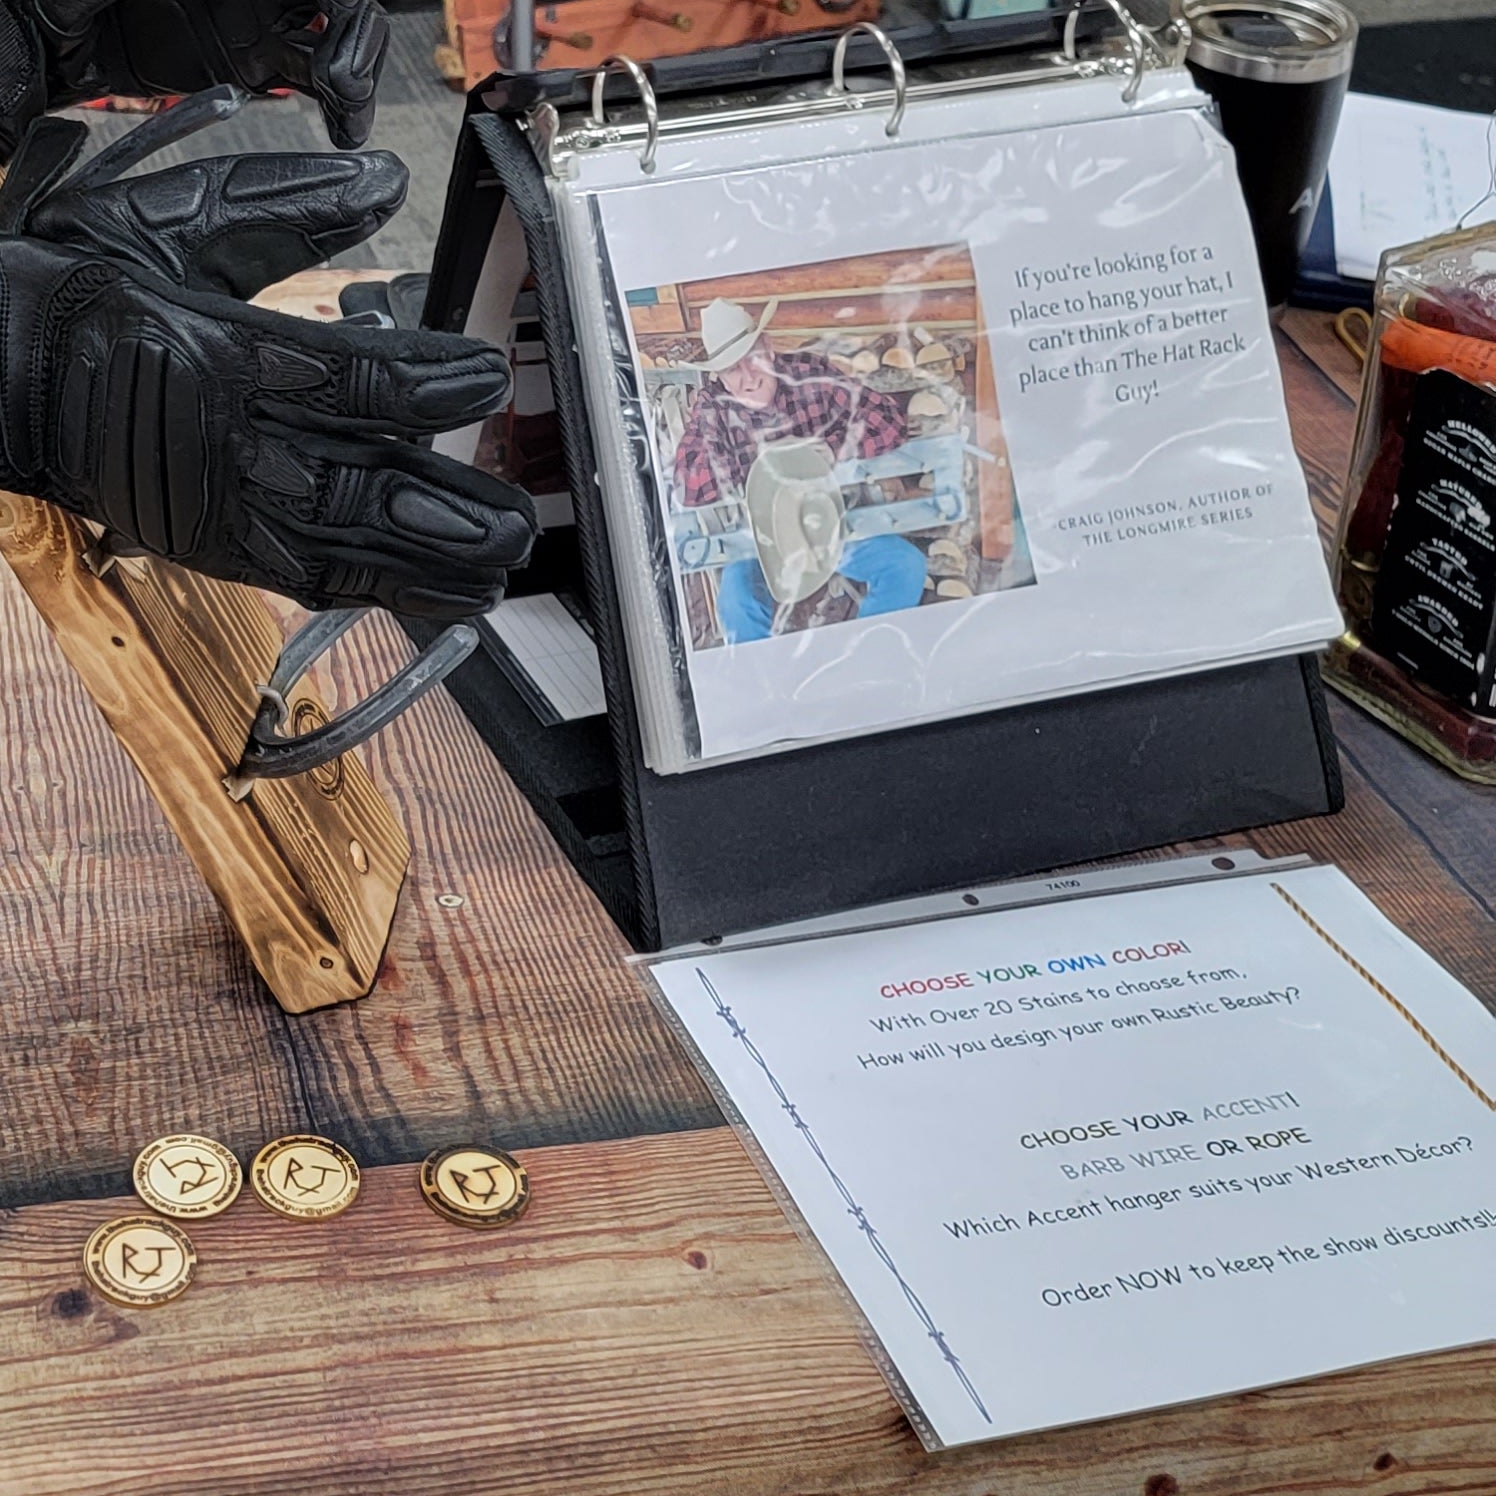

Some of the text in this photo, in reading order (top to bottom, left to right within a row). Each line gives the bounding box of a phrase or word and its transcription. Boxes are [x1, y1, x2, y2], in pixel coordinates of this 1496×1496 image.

[1014, 245, 1213, 292] If you're looking for a
[1009, 270, 1233, 327] place to hang your hat, I
[1028, 308, 1228, 352] can't think of a better
[1019, 332, 1246, 394] place than The Hat Rack
[1115, 379, 1159, 405] Guy!
[1082, 507, 1253, 545] THE LONGMIRE SERIES
[1188, 487, 1251, 509] AUTHOR
[880, 939, 1192, 999] CHOOSE YOUR OWN COLOR!
[856, 986, 1300, 1070] How will you design your own Rustic Beauty?
[868, 1012, 928, 1033] With
[929, 1007, 980, 1024] Over
[983, 999, 1014, 1016] 20
[1017, 991, 1084, 1012] Stains
[1085, 987, 1111, 1001] to
[1115, 976, 1186, 996] choose
[1020, 1090, 1301, 1149] CHOOSE YOUR ACCENT!
[1060, 1127, 1312, 1179] BARB WIRE OR ROPE
[942, 1136, 1472, 1240] Which Accent hanger suits your Western Décor?
[1041, 1281, 1113, 1307] Order
[1114, 1264, 1183, 1295] NOW
[1187, 1263, 1216, 1281] to
[1215, 1255, 1275, 1276] keep
[1276, 1244, 1321, 1265] the
[1322, 1236, 1379, 1257] show
